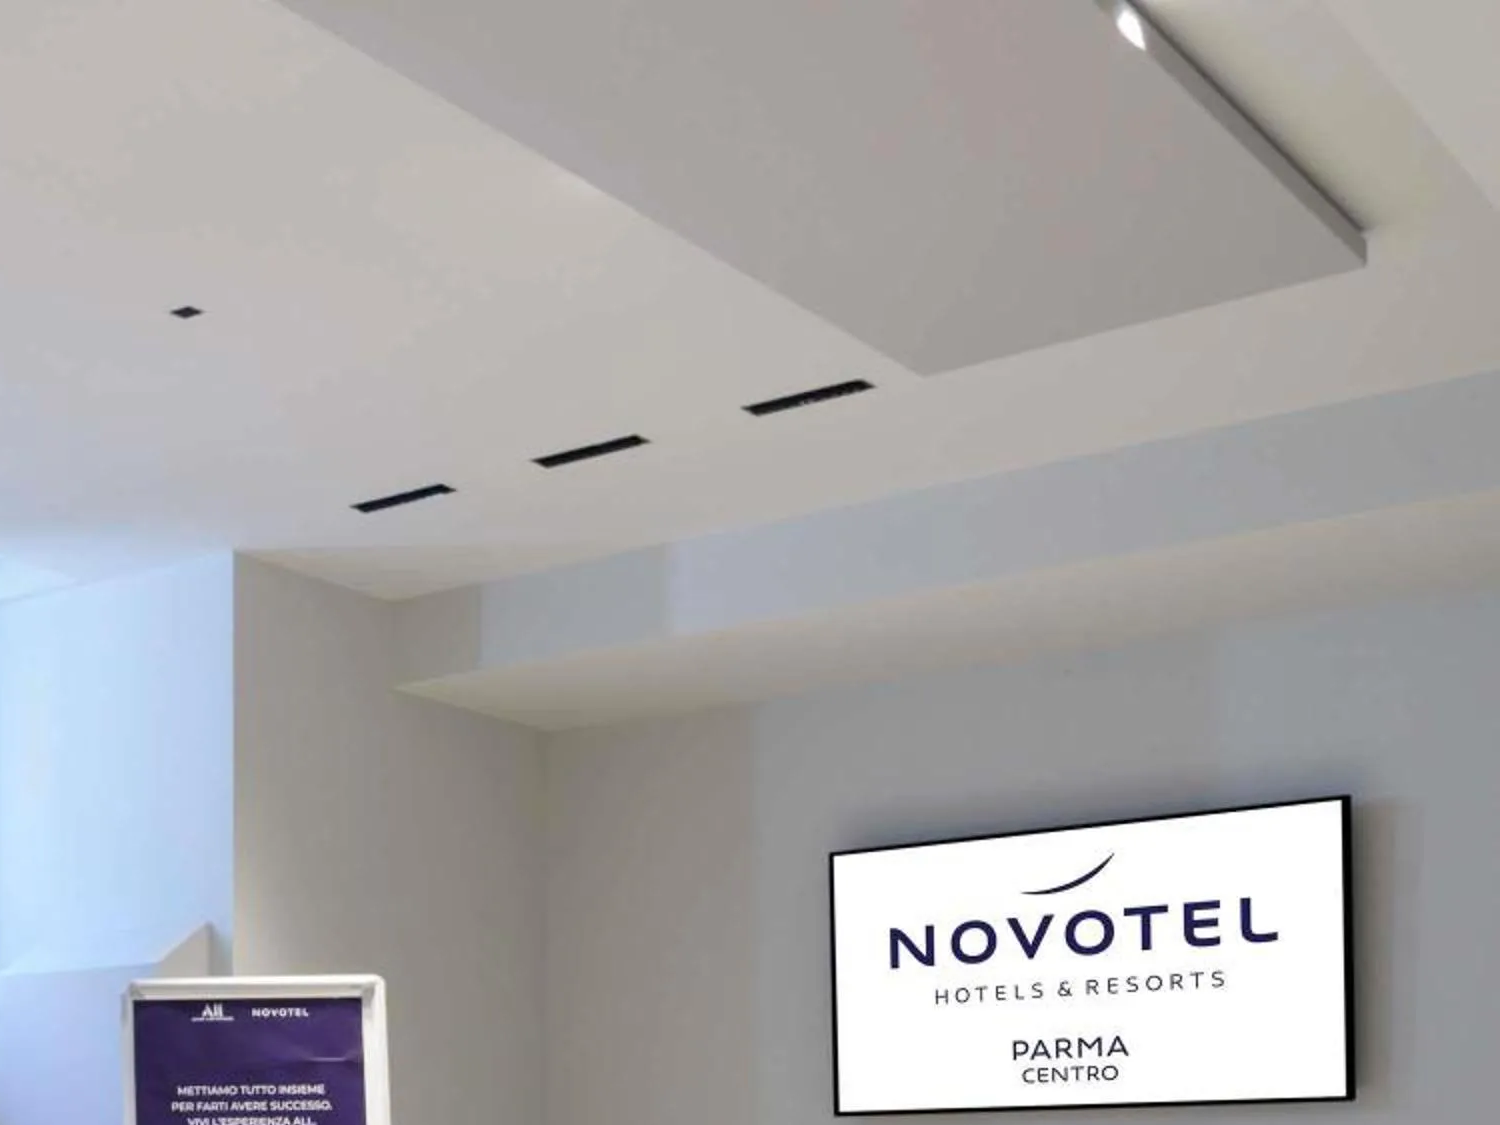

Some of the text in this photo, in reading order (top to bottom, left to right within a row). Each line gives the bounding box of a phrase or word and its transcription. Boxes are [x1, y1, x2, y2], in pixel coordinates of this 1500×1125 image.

[889, 897, 1279, 969] NOVOTEL
[934, 970, 1226, 1005] HOTELS & RESORTS
[251, 1008, 309, 1017] NOVOTEL
[1012, 1035, 1129, 1061] PARMA
[1021, 1064, 1120, 1084] CENTRO
[177, 1084, 325, 1096] METTIAMO TUTTO INSIEME
[171, 1100, 333, 1112] PER FARTI AVERE SUCCESSO.
